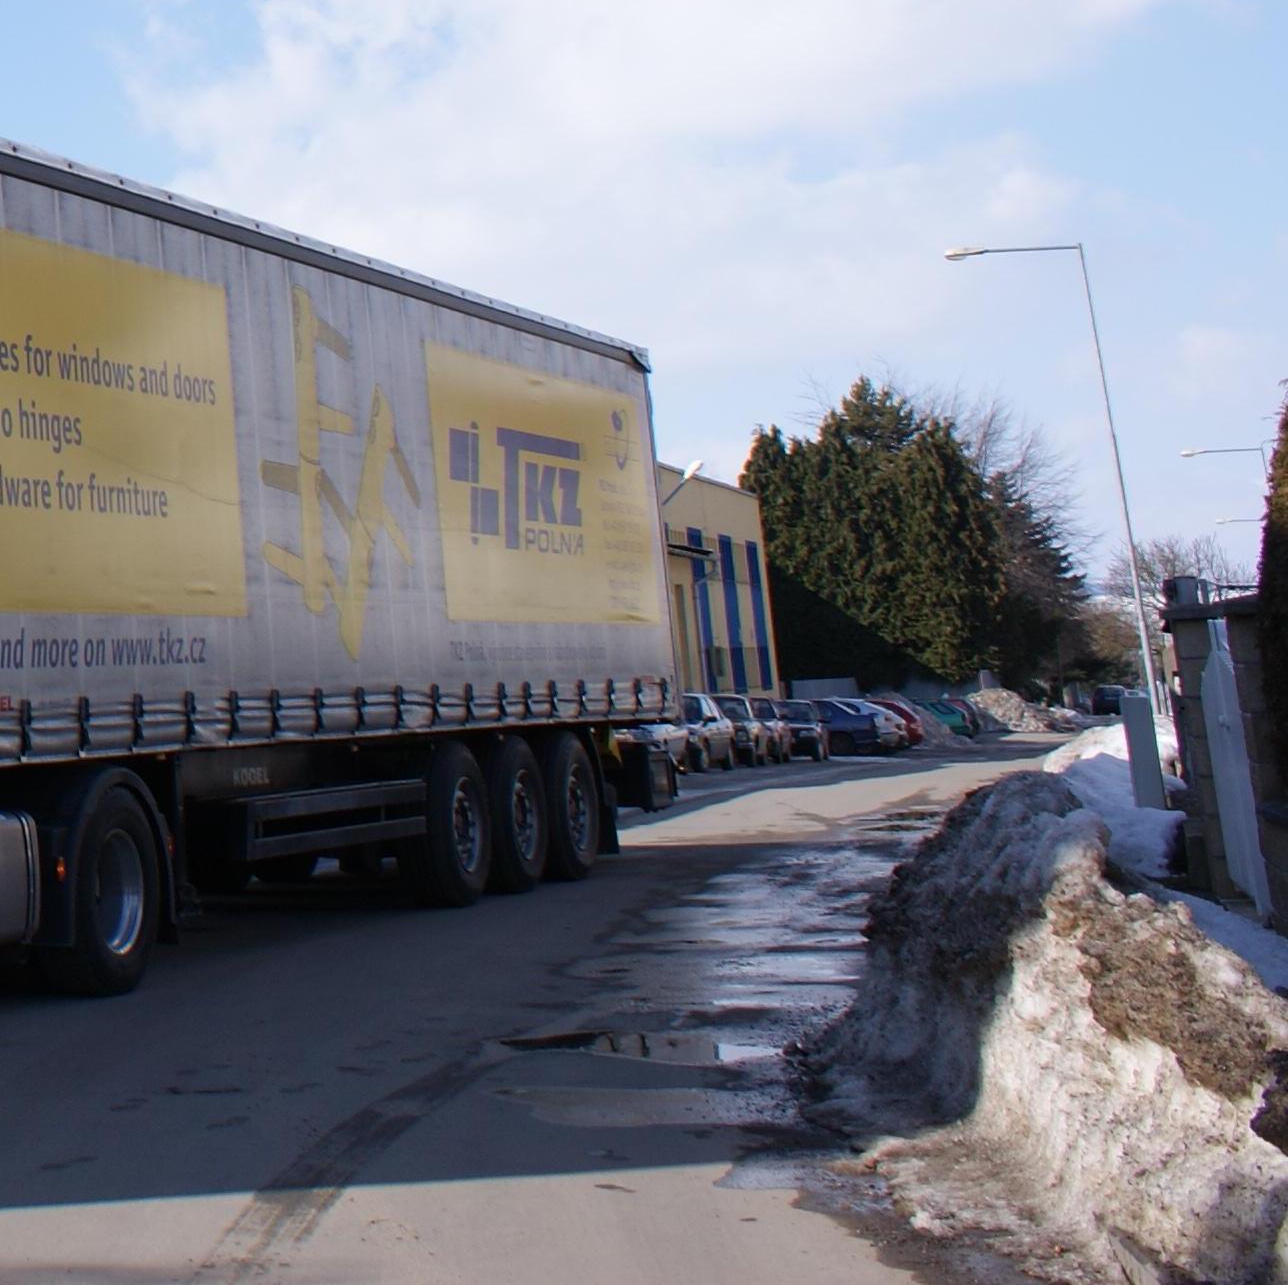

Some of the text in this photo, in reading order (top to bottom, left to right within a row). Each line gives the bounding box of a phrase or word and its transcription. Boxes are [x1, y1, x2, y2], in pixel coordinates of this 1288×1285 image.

[24, 334, 53, 378] for
[57, 343, 135, 393] windows
[139, 361, 169, 398] and
[173, 363, 217, 407] doors
[18, 398, 83, 454] hinges
[56, 469, 84, 512] for
[88, 473, 169, 518] furniture
[496, 427, 582, 550] TKZ
[31, 637, 79, 669] more
[84, 637, 106, 668] on
[111, 626, 206, 667] www.tkz.cz
